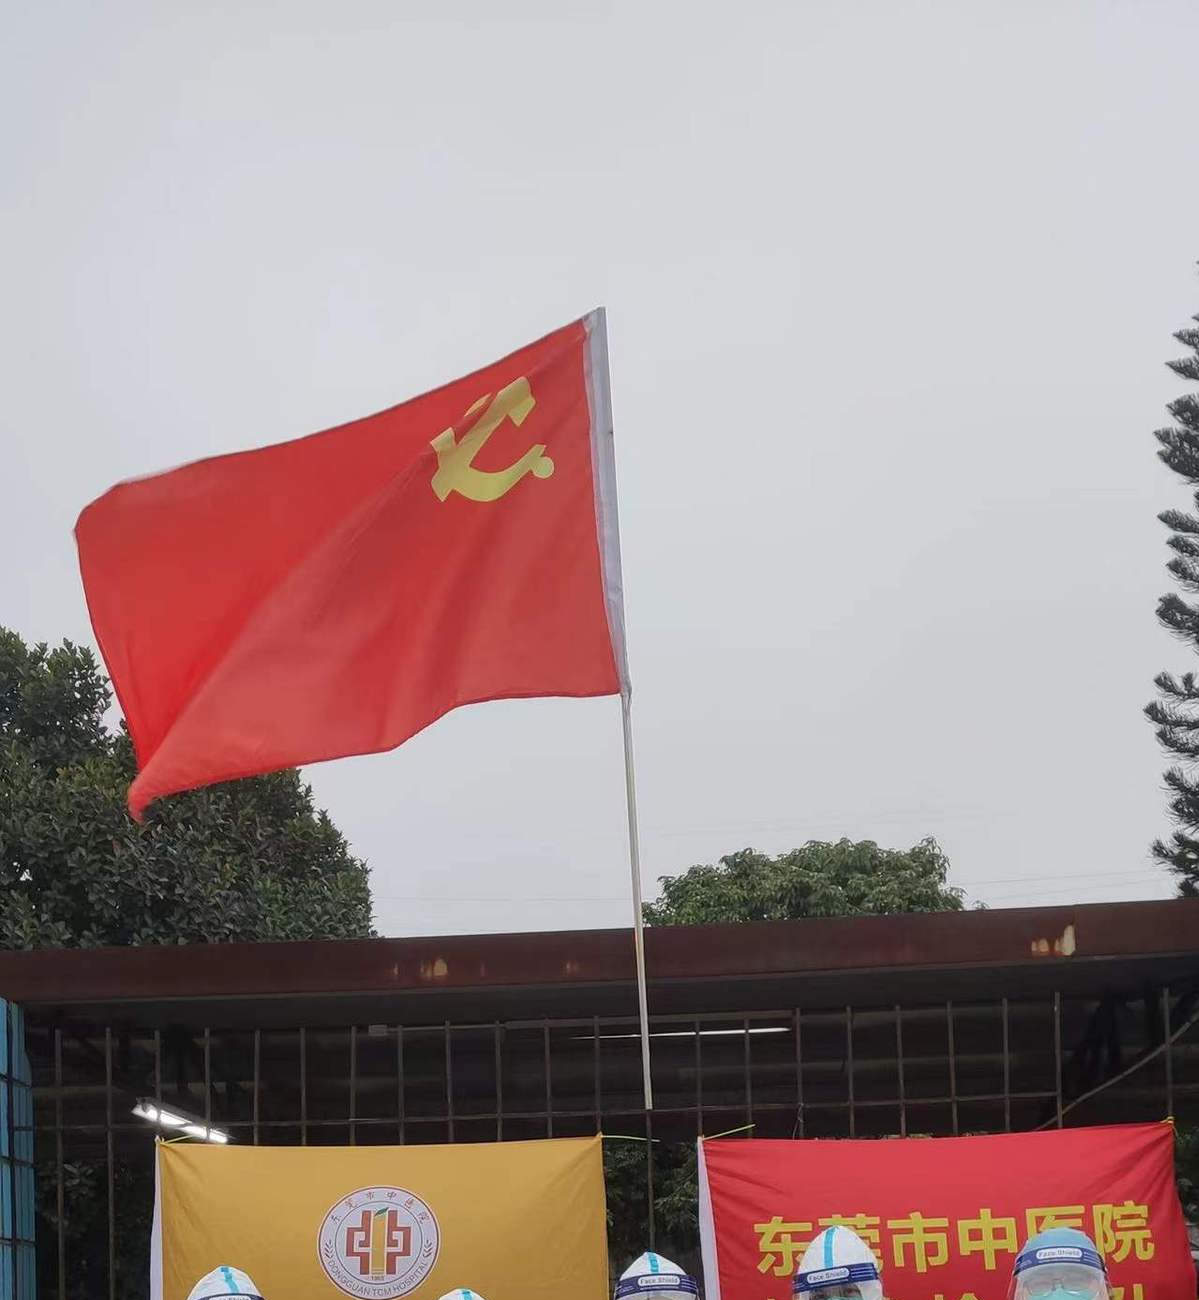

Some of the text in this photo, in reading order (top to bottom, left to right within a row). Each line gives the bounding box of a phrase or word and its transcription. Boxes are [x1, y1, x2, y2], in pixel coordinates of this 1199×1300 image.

[327, 1259, 429, 1297] DONGGUAN TCM HOSPITAL
